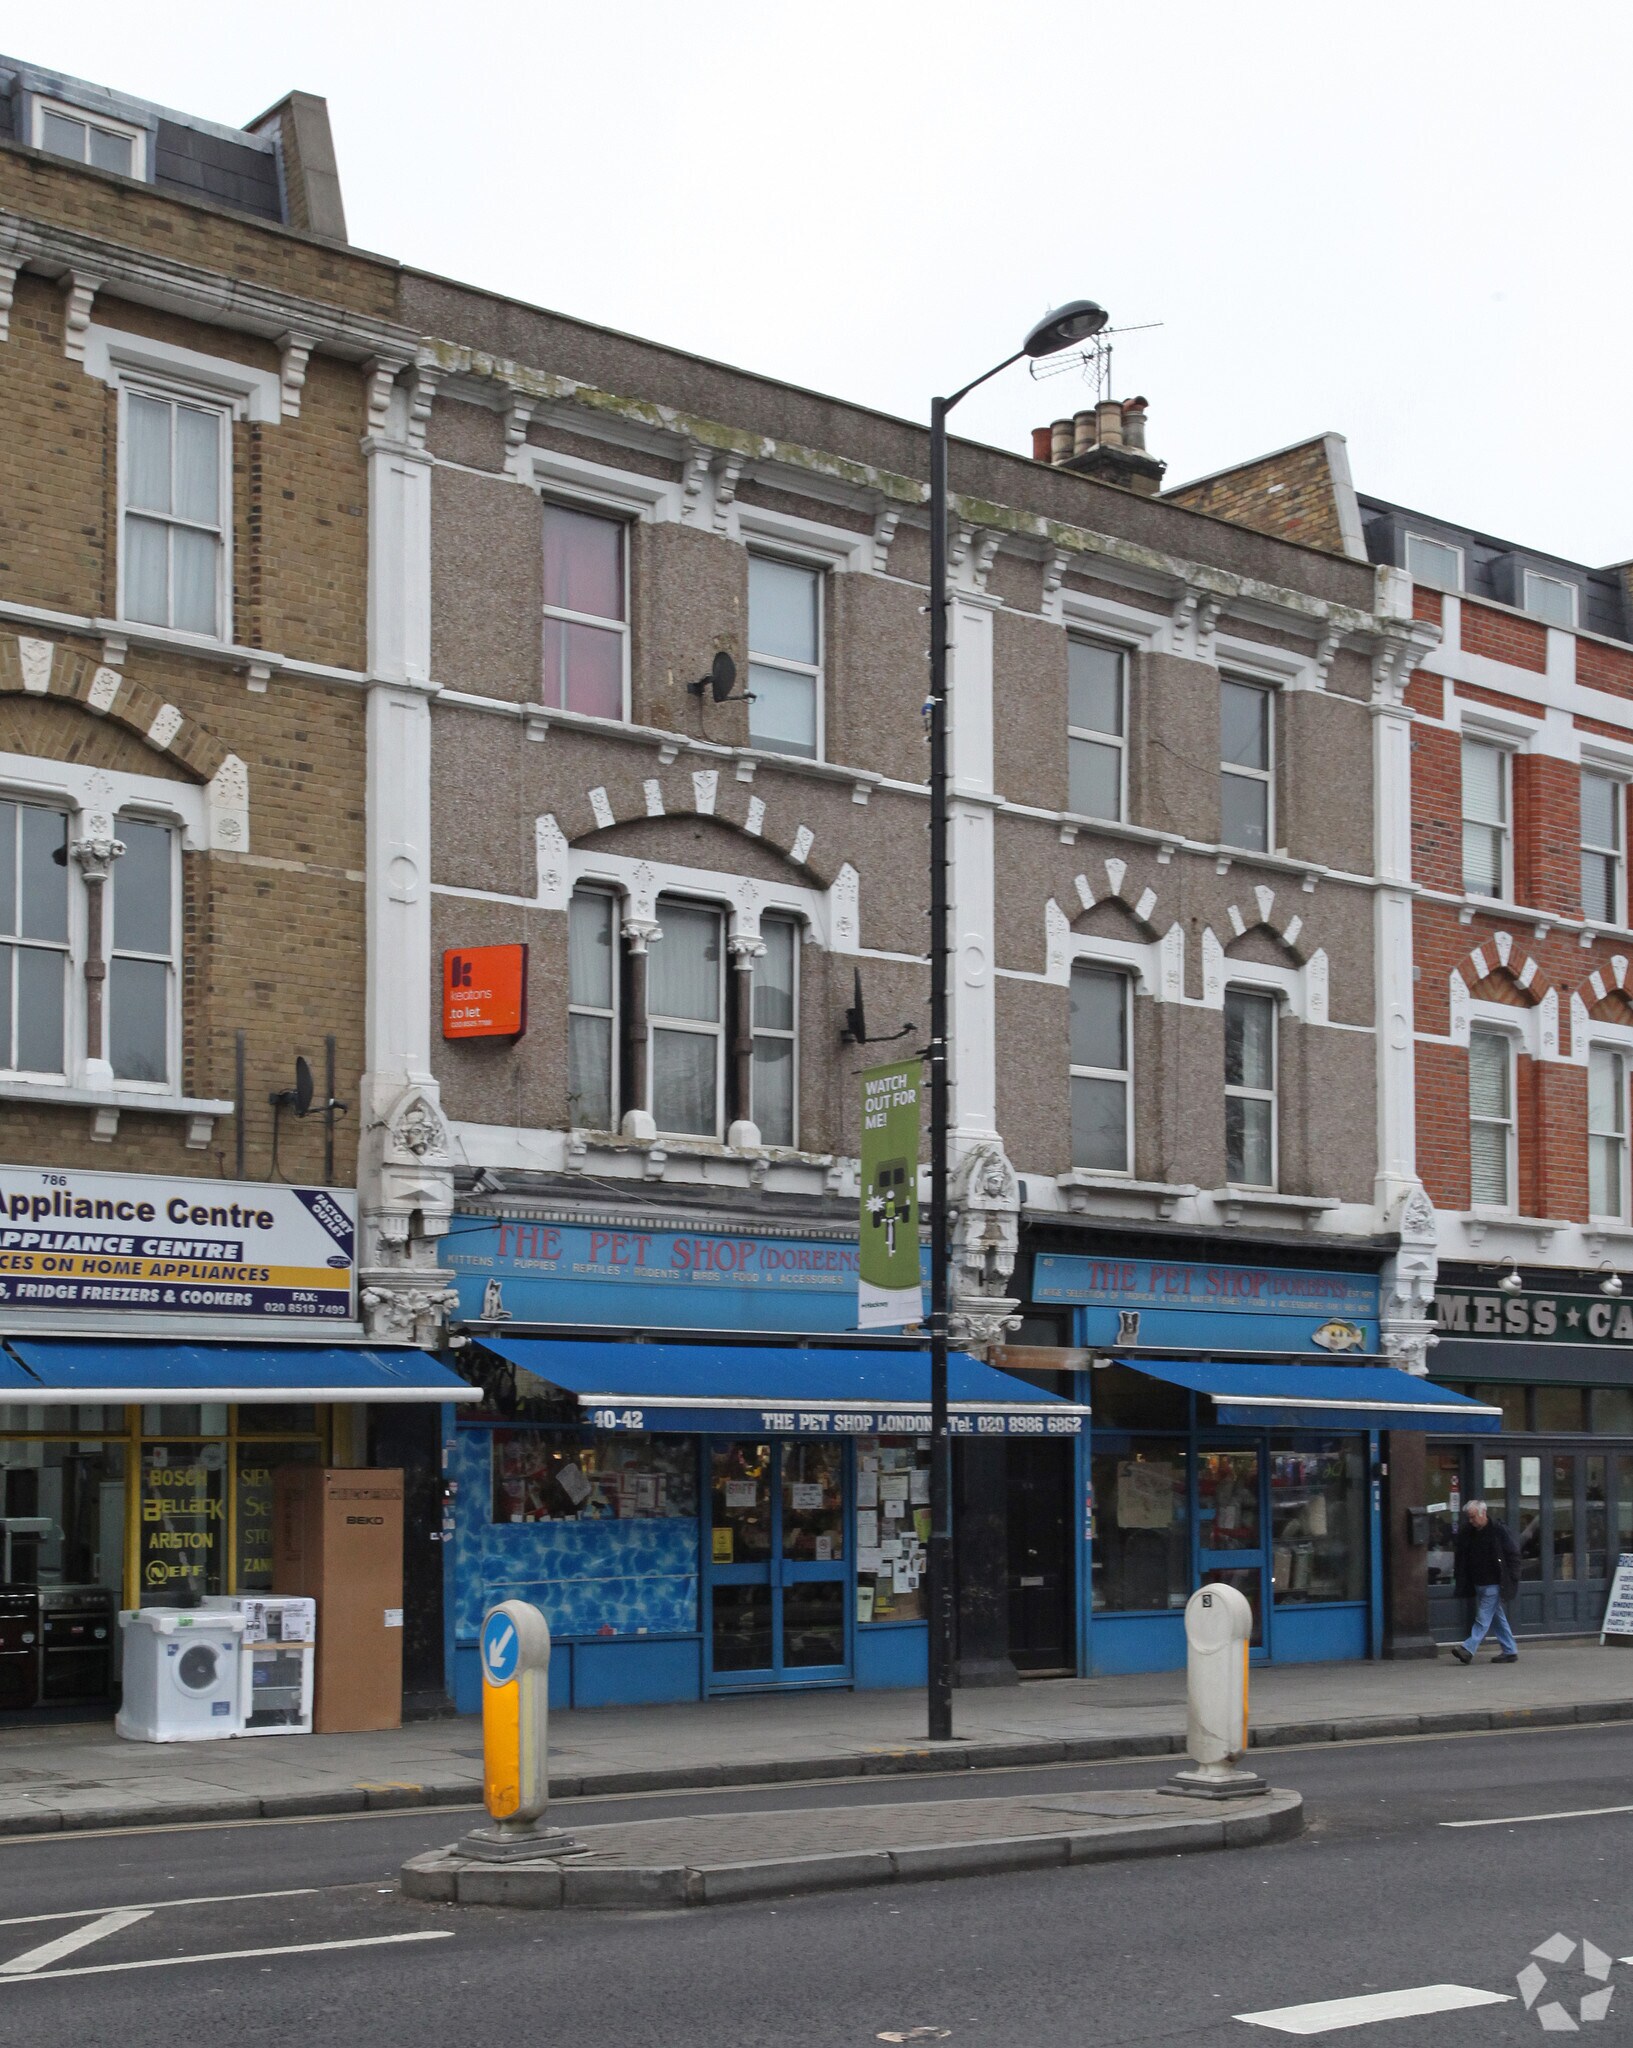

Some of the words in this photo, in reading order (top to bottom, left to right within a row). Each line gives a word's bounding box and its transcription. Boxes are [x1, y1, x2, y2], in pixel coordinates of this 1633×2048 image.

[465, 1006, 481, 1018] let
[864, 1073, 908, 1096] WATCH
[864, 1095, 891, 1113] OUT
[893, 1088, 917, 1107] FOR
[864, 1112, 888, 1130] ME!
[42, 1174, 67, 1186] 786
[167, 1199, 274, 1230] Centre
[311, 1202, 347, 1240] OUTLET
[314, 1193, 354, 1234] FACTORY
[142, 1239, 240, 1261] CENTRE
[493, 1224, 563, 1260] THE
[588, 1231, 652, 1267] PET
[671, 1237, 757, 1271] SHOP
[42, 1257, 74, 1273] ON
[82, 1259, 143, 1276] HOME
[149, 1263, 271, 1282] APPLIANCES
[447, 1254, 494, 1267] KITTENS
[513, 1258, 557, 1271] PUPPIES
[572, 1263, 621, 1276] REPTILES
[634, 1267, 680, 1280] RODENTS
[692, 1270, 721, 1282] BIRDS
[733, 1272, 759, 1283] FOOD
[779, 1273, 844, 1285] ACCESSORIES
[1088, 1261, 1137, 1292] THE
[1149, 1265, 1196, 1295] PET
[1206, 1269, 1268, 1298] SHOP
[16, 1283, 77, 1300] FRIDGE
[81, 1286, 160, 1304] FREEZERS
[163, 1289, 176, 1304] &
[180, 1289, 254, 1308] COOKERS
[292, 1292, 319, 1303] FAX:
[264, 1302, 286, 1313] 020
[288, 1303, 317, 1314] 8519
[318, 1304, 346, 1316] 7499
[1434, 1293, 1557, 1335] MESS
[594, 1410, 643, 1429] 40-42
[761, 1412, 795, 1430] THE
[799, 1413, 831, 1431] PET
[834, 1413, 873, 1432] SHOP
[877, 1415, 933, 1433] LONDON
[947, 1415, 973, 1433] Tel:
[977, 1416, 1005, 1433] 020
[1008, 1416, 1044, 1433] 8986
[150, 1469, 208, 1487] BOSCH
[346, 1515, 384, 1525] BEKO
[149, 1532, 214, 1548] ARISTON
[145, 1560, 205, 1586] NEFF
